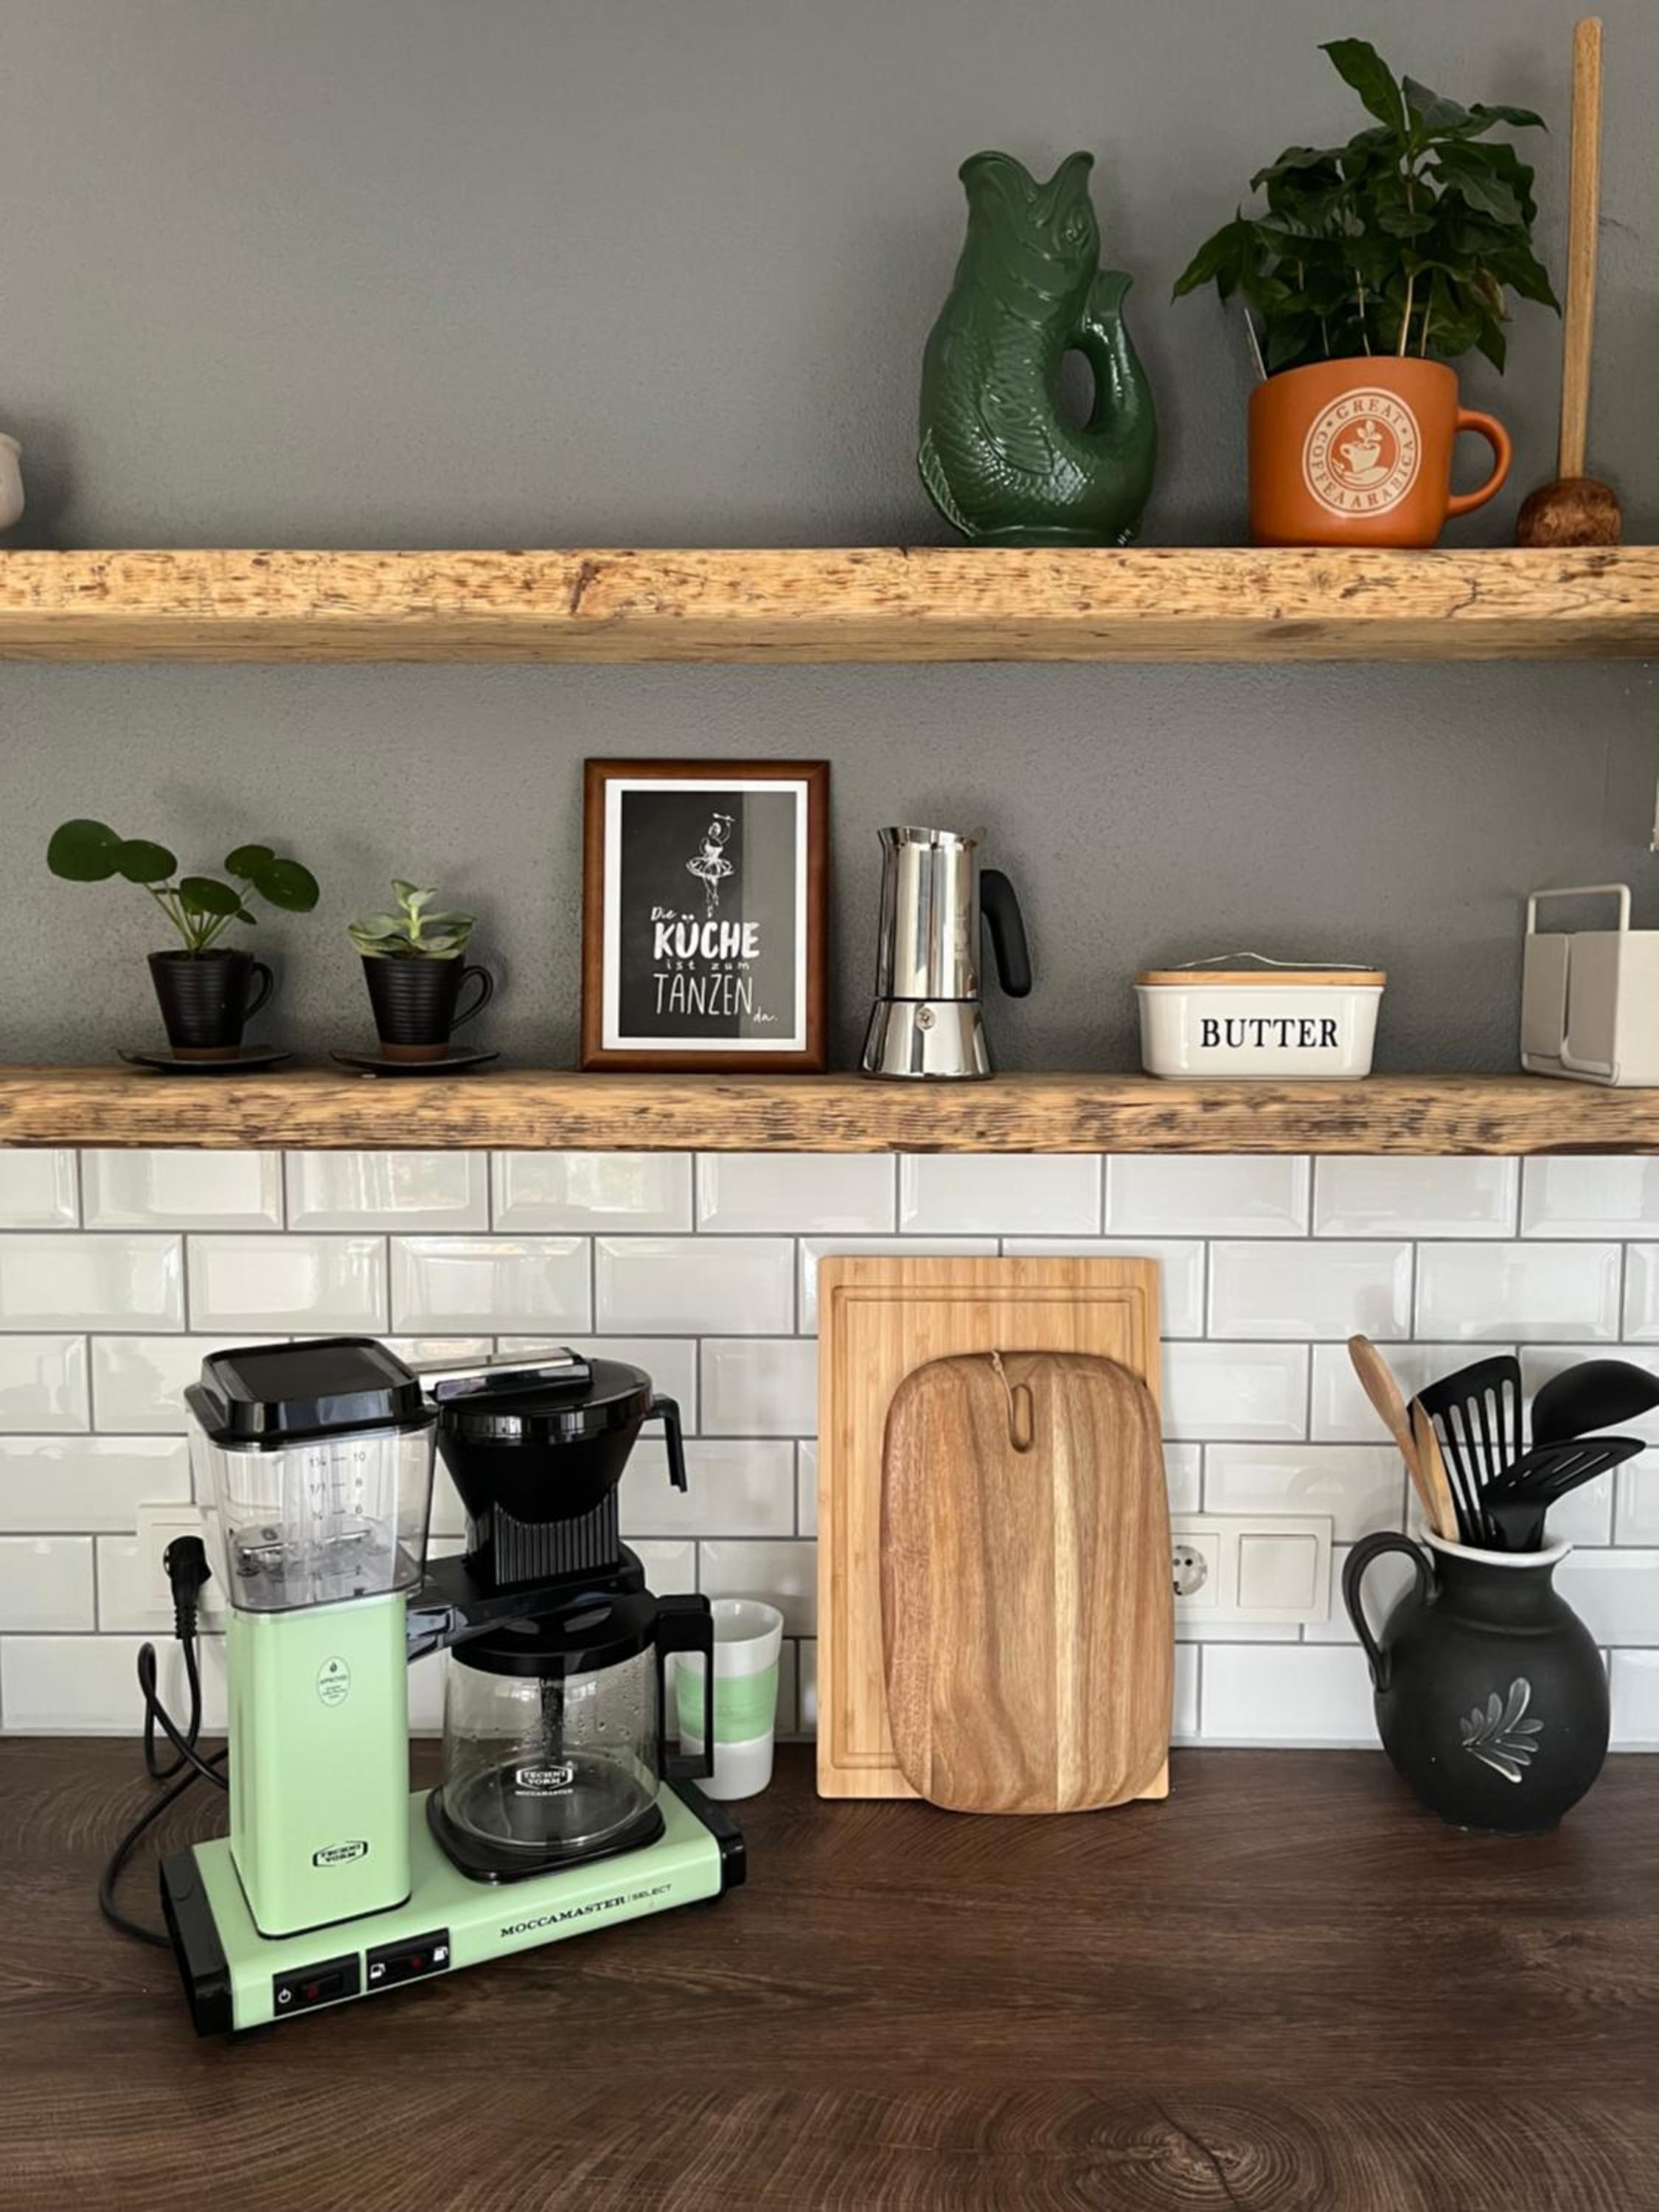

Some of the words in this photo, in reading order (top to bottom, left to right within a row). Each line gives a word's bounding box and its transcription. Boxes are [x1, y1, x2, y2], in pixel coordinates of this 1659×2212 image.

[1336, 399, 1404, 424] GREAT
[650, 906, 677, 921] Die
[653, 914, 760, 960] KÜCHE
[667, 959, 695, 970] ist
[711, 961, 750, 970] zum
[653, 973, 753, 1015] TANZEN
[1200, 1018, 1338, 1048] BUTTER
[501, 1895, 626, 1938] MOCCAMASTER
[632, 1884, 672, 1901] SELECT
